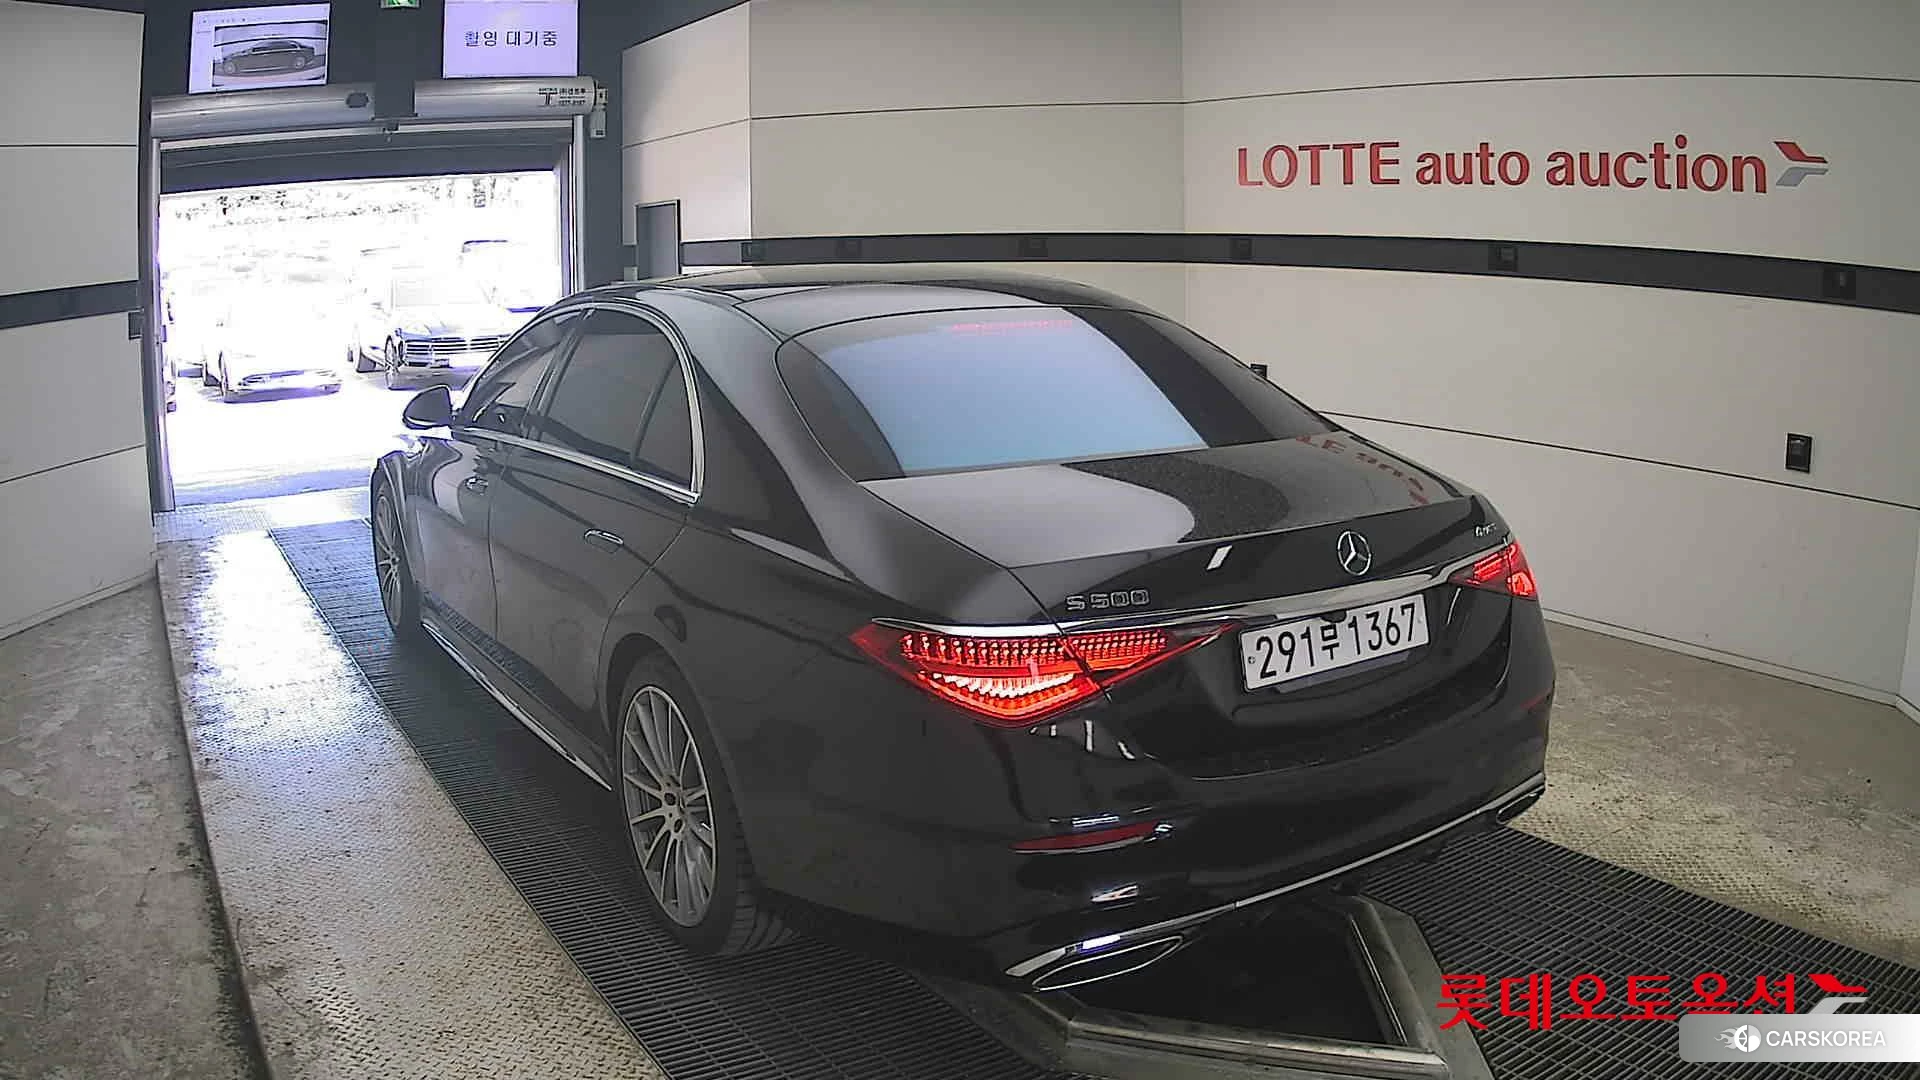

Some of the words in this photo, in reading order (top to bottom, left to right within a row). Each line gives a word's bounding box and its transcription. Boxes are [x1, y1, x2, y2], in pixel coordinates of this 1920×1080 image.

[505, 30, 559, 47] 대기중
[1236, 142, 1401, 189] LOTTE
[1415, 142, 1531, 188] auto
[1545, 133, 1767, 194] auction
[1066, 595, 1085, 611] S
[1090, 589, 1150, 609] 500
[1256, 602, 1416, 680] 291무1367
